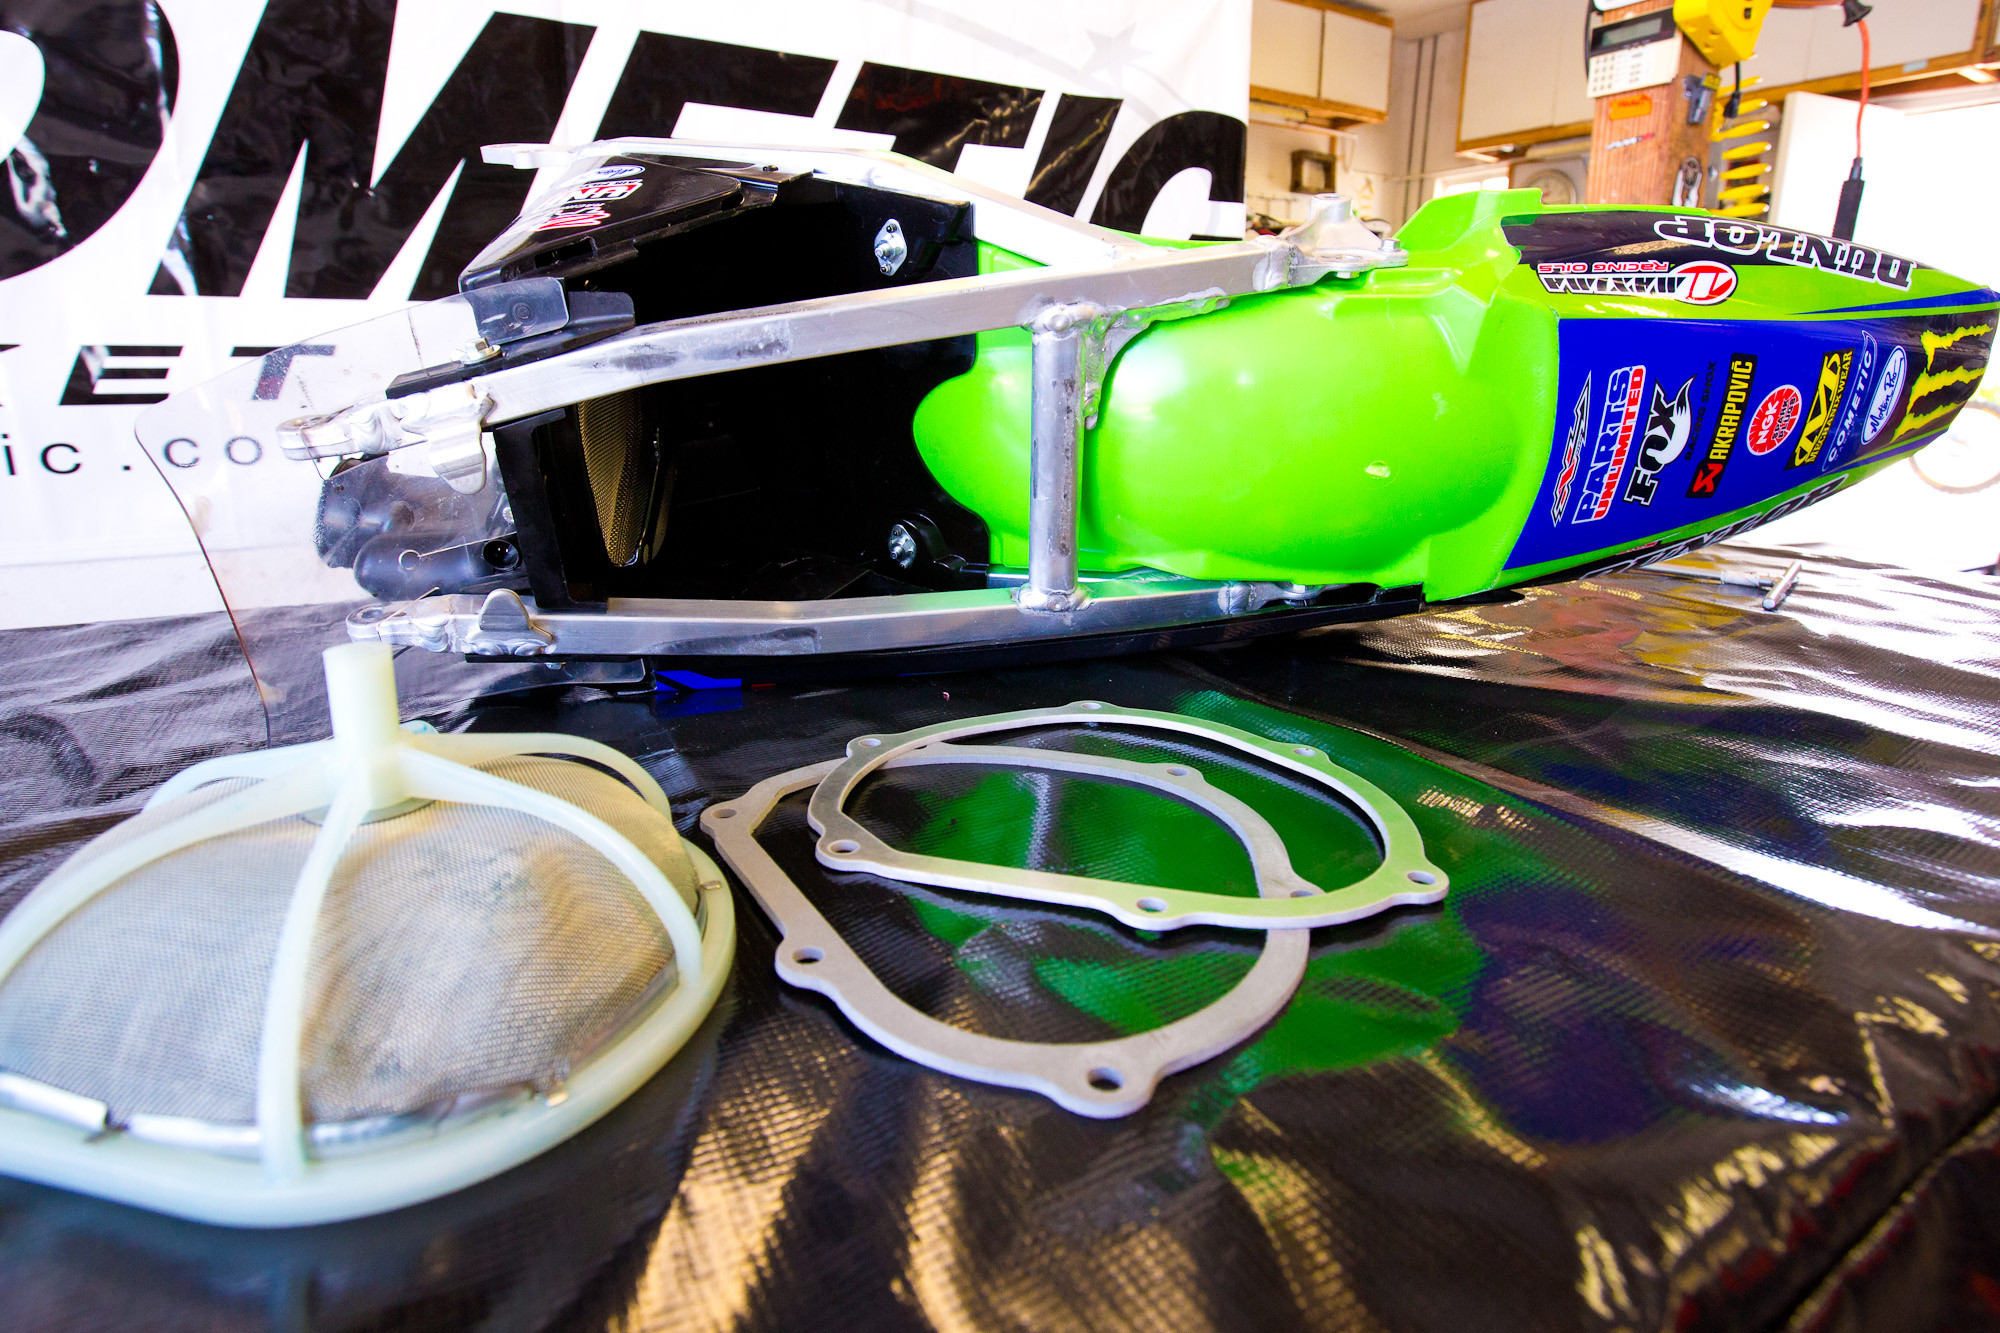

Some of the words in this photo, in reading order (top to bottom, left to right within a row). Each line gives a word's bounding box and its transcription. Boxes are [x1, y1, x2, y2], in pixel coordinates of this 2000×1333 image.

[1539, 263, 1587, 272] OILS
[1544, 276, 1686, 295] MAXIMA
[1593, 260, 1669, 272] RACING
[1653, 215, 1918, 291] DUNLOP
[0, 344, 336, 405] ET
[1806, 393, 1842, 463] MECHANIX
[1838, 350, 1853, 393] WEAR
[1828, 350, 1872, 462] COMETIC
[1593, 366, 1645, 520] UNLIMITED
[1623, 375, 1693, 507] FOX
[1684, 406, 1706, 461] RACING
[1701, 360, 1717, 403] SHOX
[1709, 360, 1753, 460] AKRAPOVIČ
[1757, 400, 1780, 445] NGK
[1771, 399, 1790, 441] SPARK
[1778, 397, 1796, 439] PLUGS
[1871, 394, 1892, 434] Motion
[1571, 367, 1632, 524] PARTS
